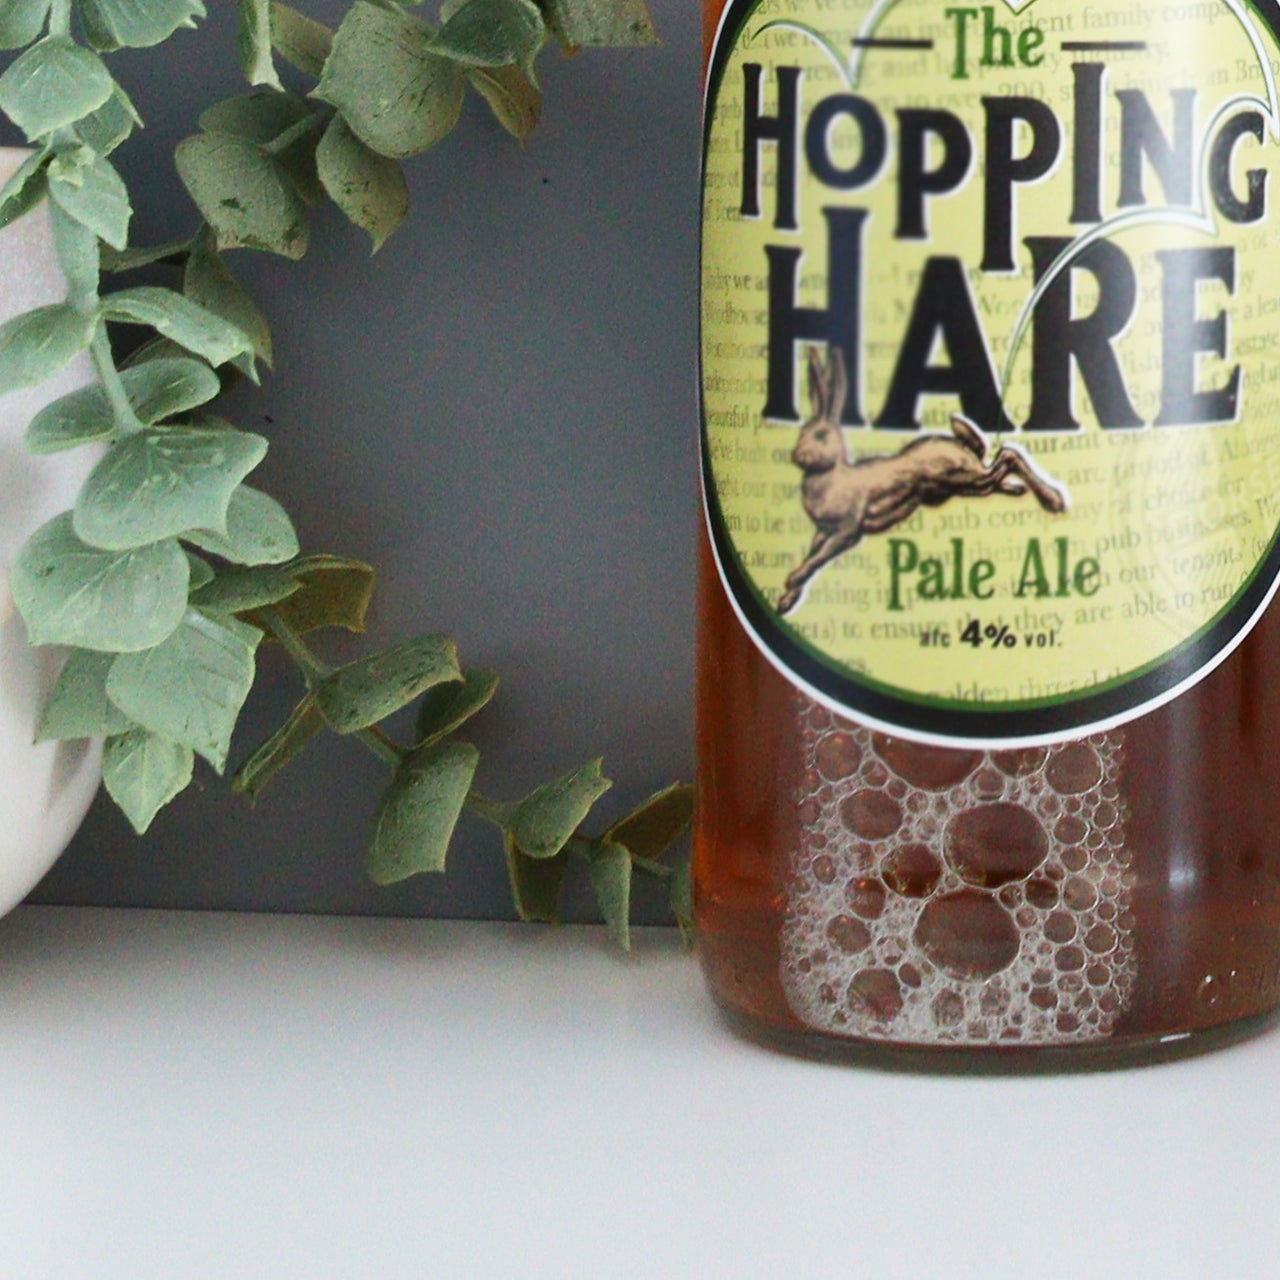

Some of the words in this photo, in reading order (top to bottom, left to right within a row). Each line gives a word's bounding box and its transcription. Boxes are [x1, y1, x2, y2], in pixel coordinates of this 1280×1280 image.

[944, 5, 1046, 80] The
[1082, 3, 1155, 32] family
[741, 62, 1269, 272] HOPPING
[761, 205, 1243, 433] HARE
[886, 537, 996, 611] Pale
[1015, 536, 1101, 598] Ale
[1074, 605, 1114, 626] are
[1120, 591, 1168, 619] able
[1173, 590, 1196, 610] to
[959, 617, 1018, 649] 4%
[1024, 627, 1063, 648] vol.
